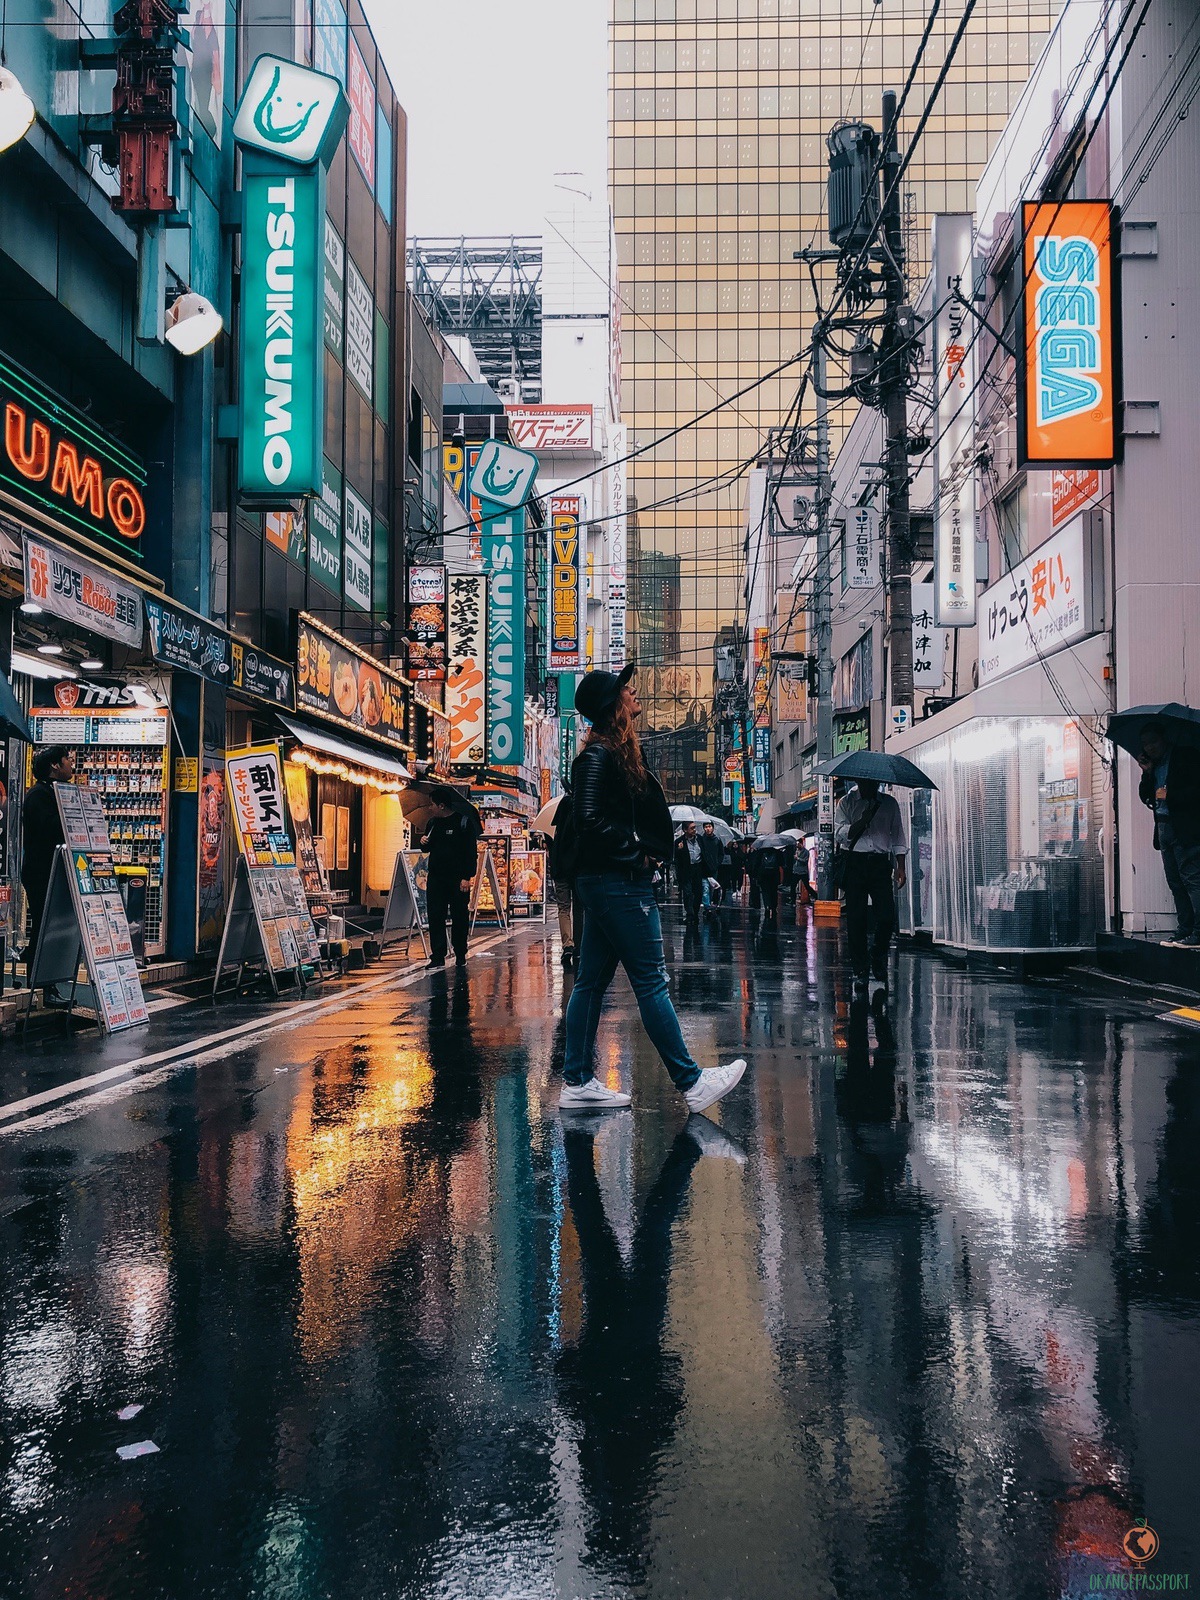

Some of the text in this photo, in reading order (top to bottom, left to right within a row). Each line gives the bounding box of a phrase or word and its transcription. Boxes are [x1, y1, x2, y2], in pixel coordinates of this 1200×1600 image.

[263, 177, 295, 486] TSUKUMO
[349, 309, 371, 354] コミック
[1035, 236, 1102, 427] SEGA
[551, 500, 579, 512] 24H
[310, 532, 341, 579] 同人フロア
[855, 523, 869, 567] 千石電商
[30, 557, 49, 599] 3F
[411, 578, 442, 586] eternal
[553, 515, 577, 639] DVD鑑賞
[988, 551, 1071, 642] けっこう安い。
[417, 631, 438, 641] 2F
[450, 577, 481, 657] 横浜家系
[490, 516, 514, 760] TSUKUMO
[913, 609, 934, 673] 赤津加
[417, 669, 438, 679] 2F
